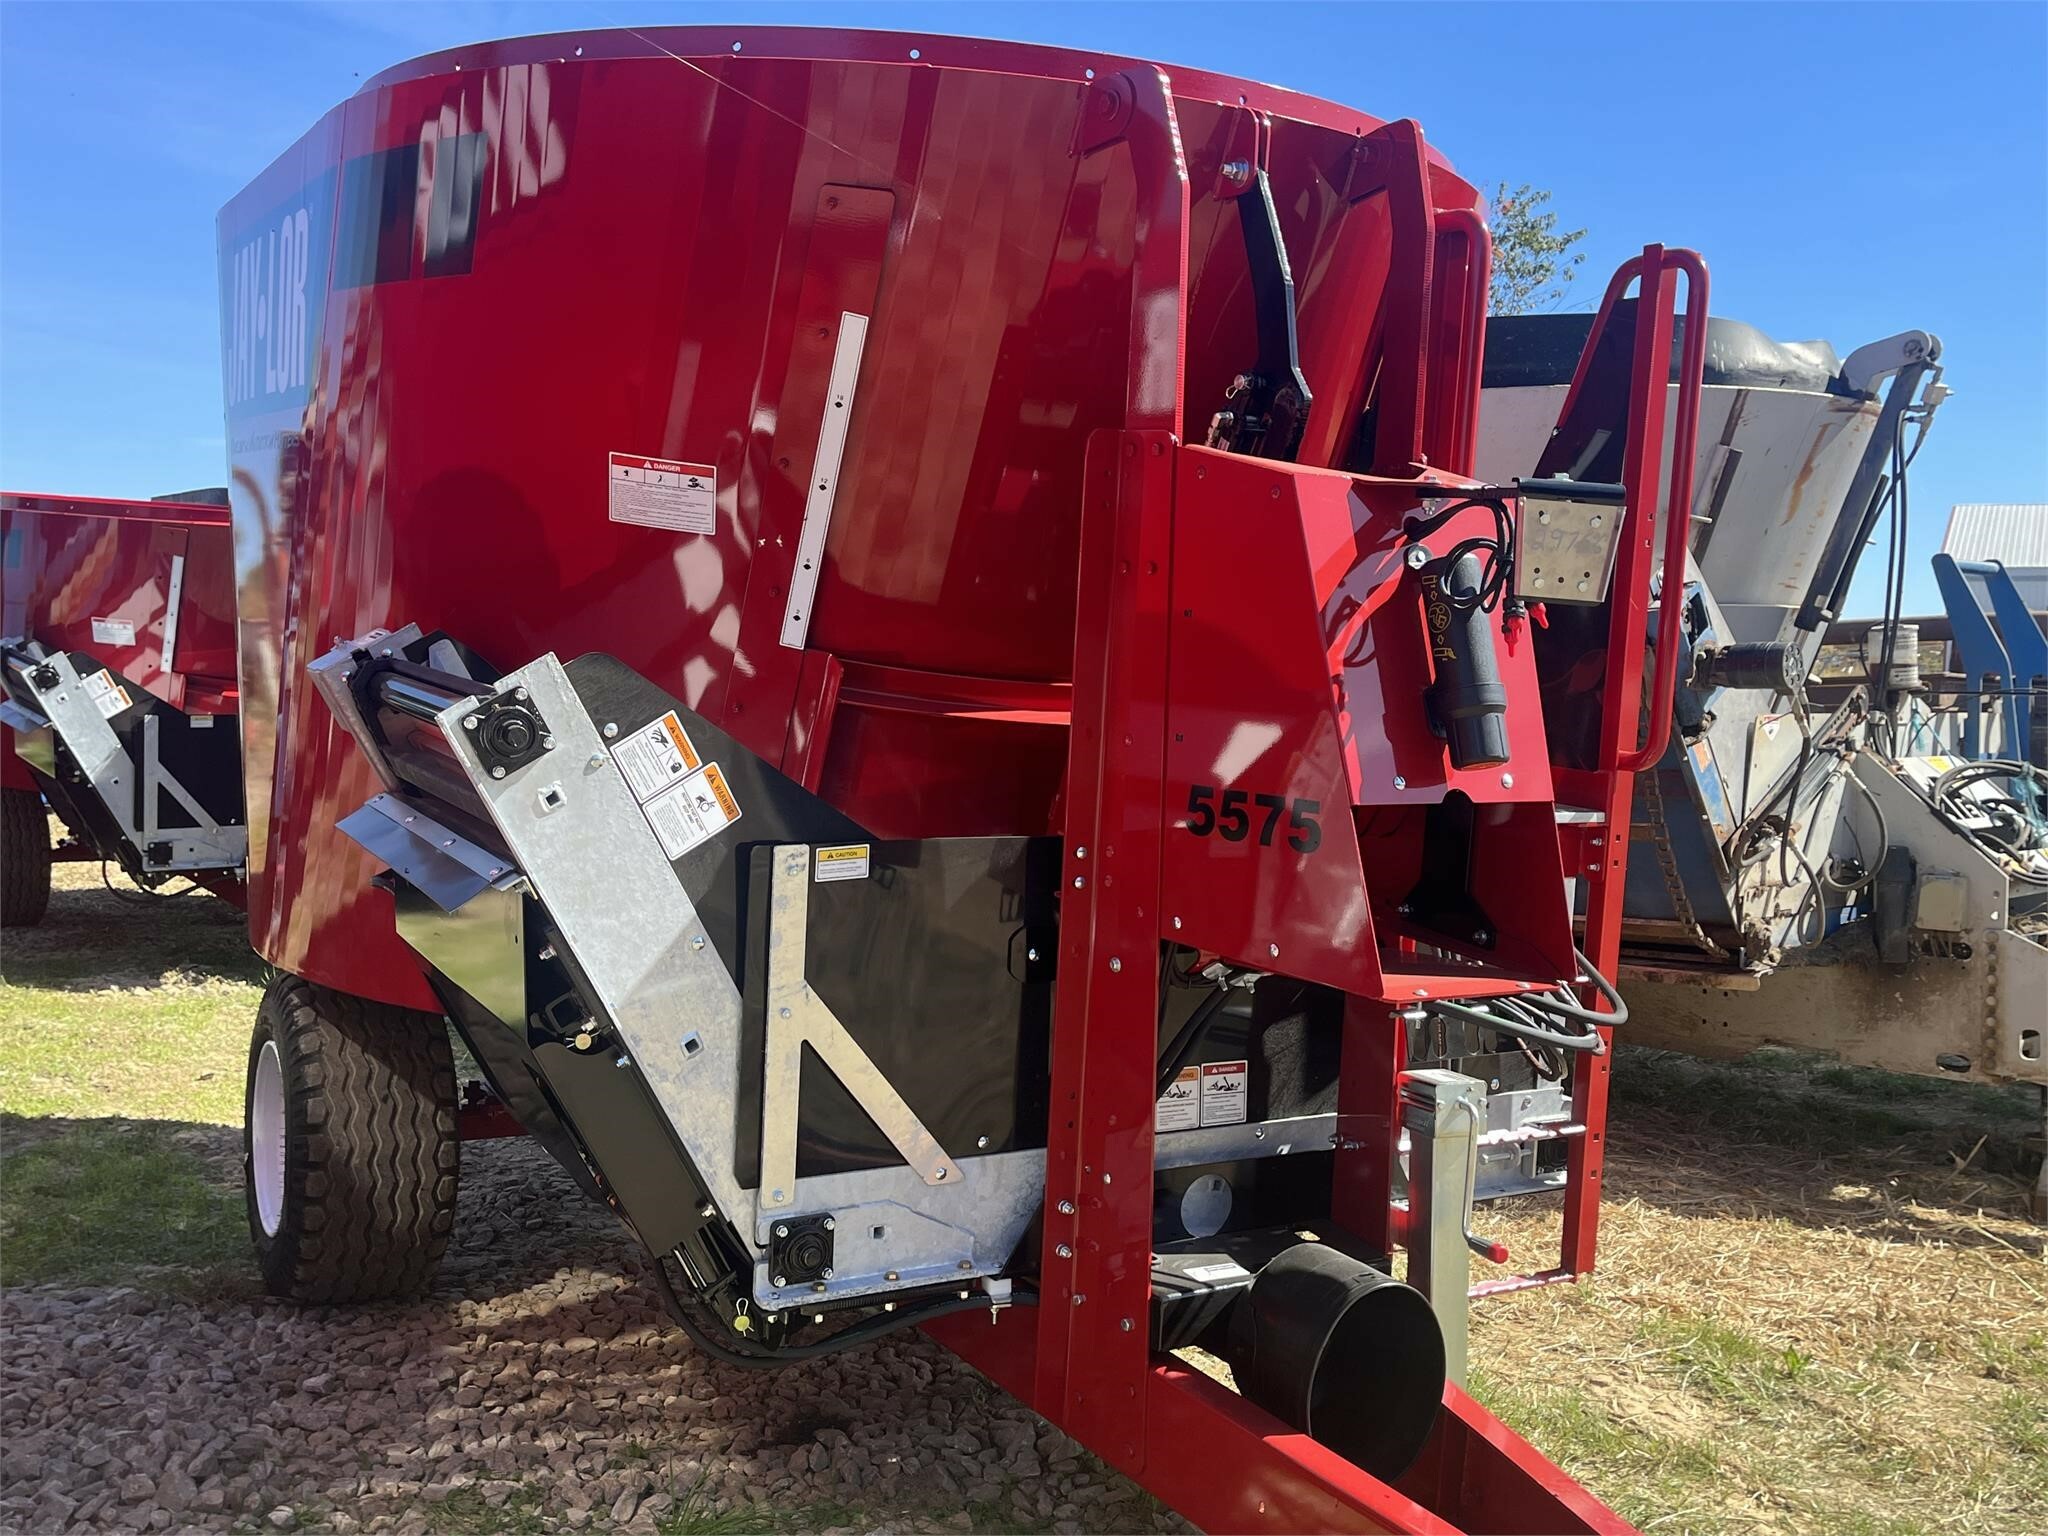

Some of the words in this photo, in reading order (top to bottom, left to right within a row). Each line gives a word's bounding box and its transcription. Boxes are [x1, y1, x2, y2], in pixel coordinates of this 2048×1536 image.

[653, 462, 681, 472] DANGER
[714, 785, 735, 816] WARNING
[1186, 784, 1322, 854] 5575
[1218, 1065, 1237, 1073] DANGER
